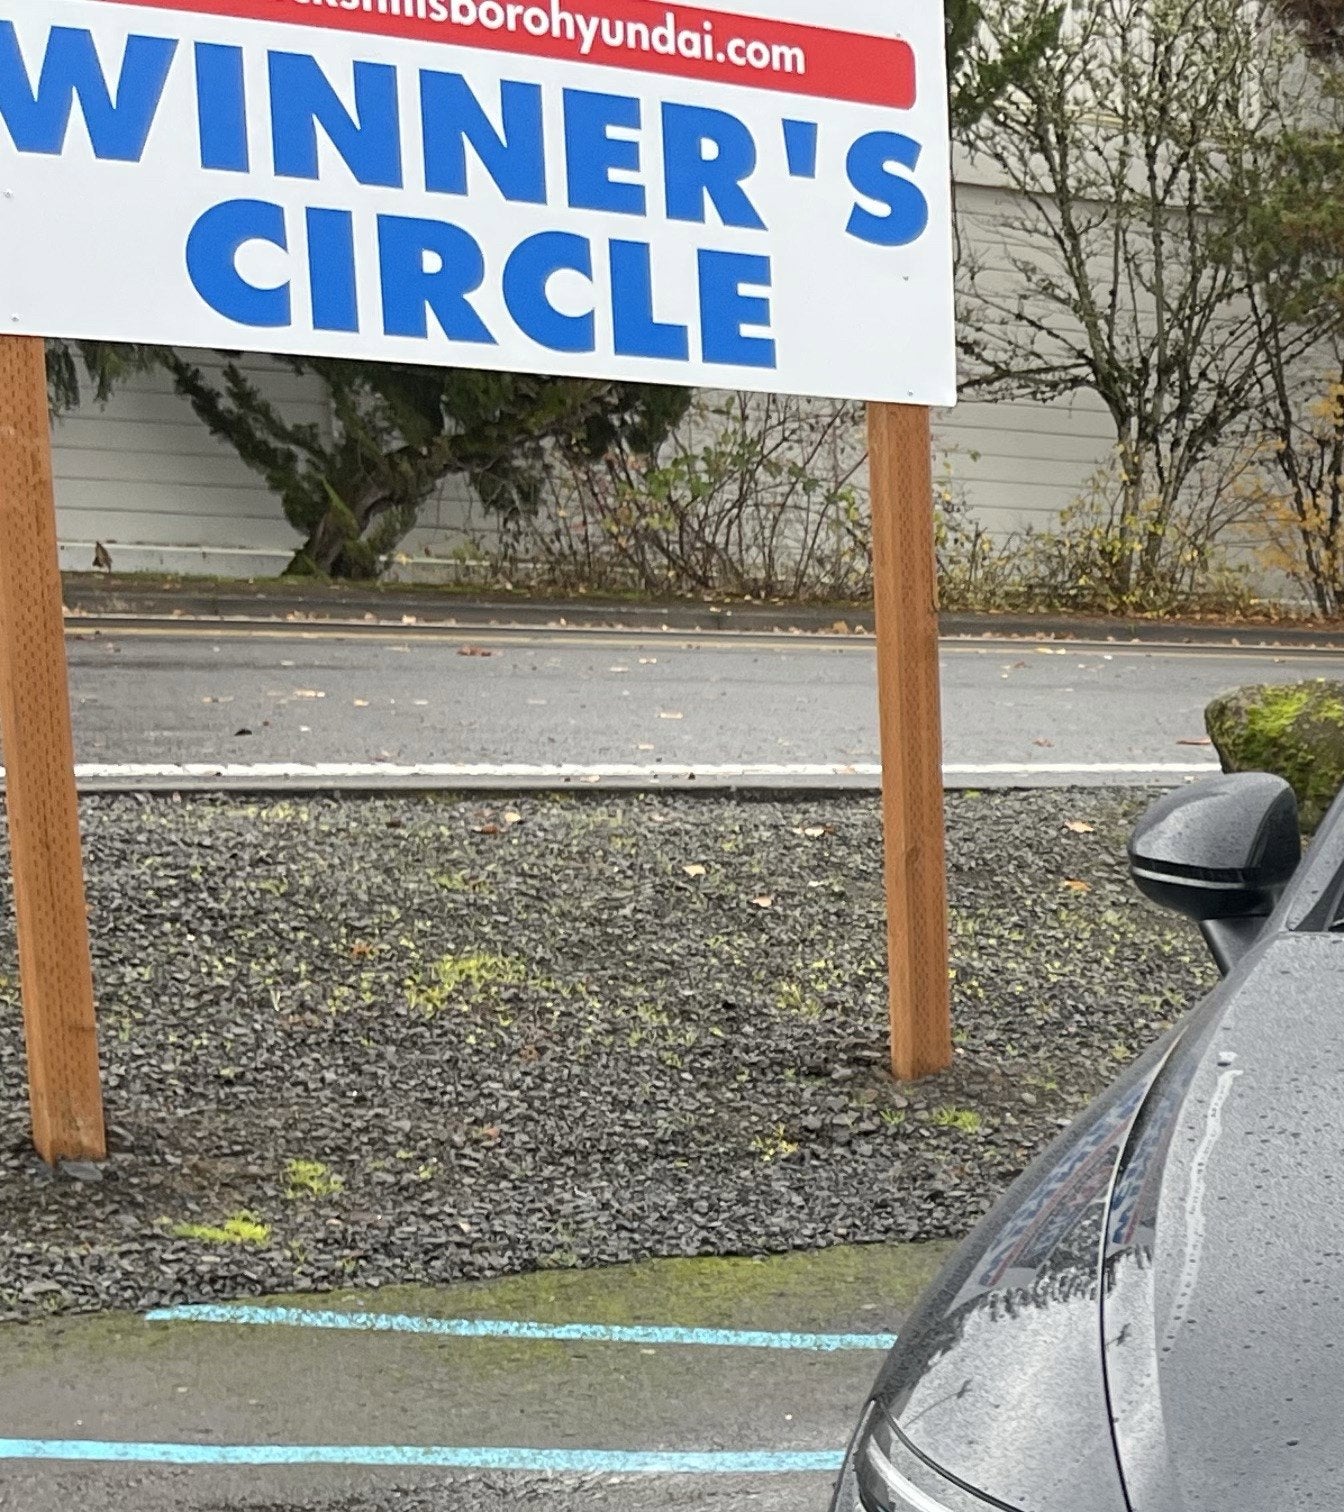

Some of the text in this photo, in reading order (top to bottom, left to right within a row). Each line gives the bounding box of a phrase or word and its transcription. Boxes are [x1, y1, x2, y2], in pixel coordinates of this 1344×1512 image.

[292, 0, 806, 75] sborohyundai.com
[0, 20, 928, 247] WINNER'S
[185, 199, 777, 369] CIRCLE
